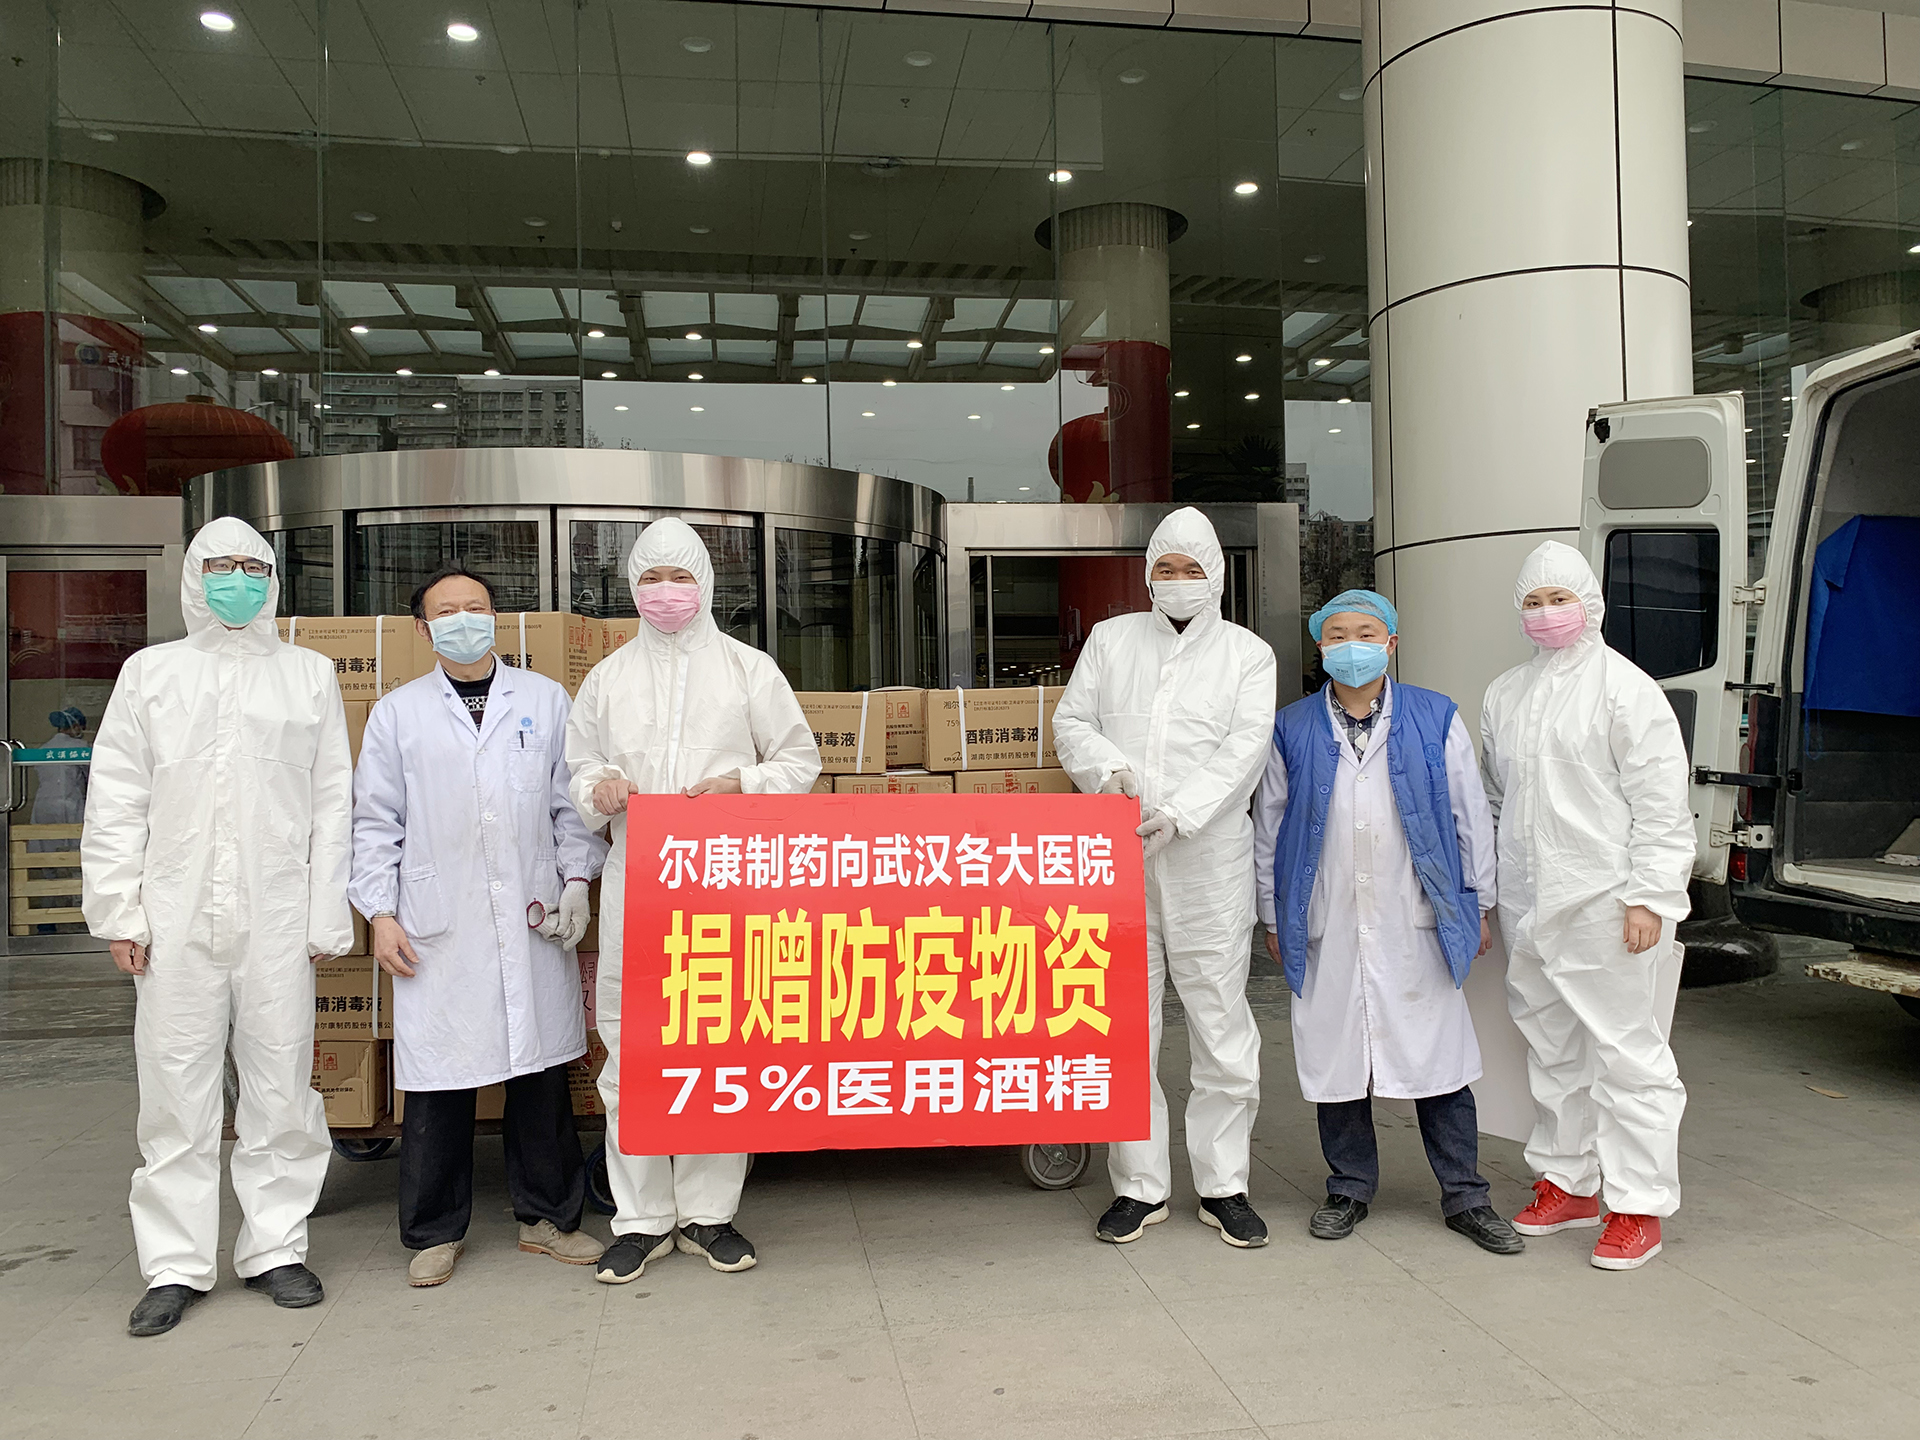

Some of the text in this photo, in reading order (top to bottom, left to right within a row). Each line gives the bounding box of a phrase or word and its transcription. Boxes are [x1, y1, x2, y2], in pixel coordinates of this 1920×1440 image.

[820, 756, 872, 764] 药股份有限司
[971, 751, 1058, 761] 湖南尔康制药股份有公司
[658, 833, 1115, 889] 尔康制药向武汉各大医院
[661, 905, 1112, 1045] 捐赠防疫物资
[661, 1054, 1112, 1116] 75%医用酒精
